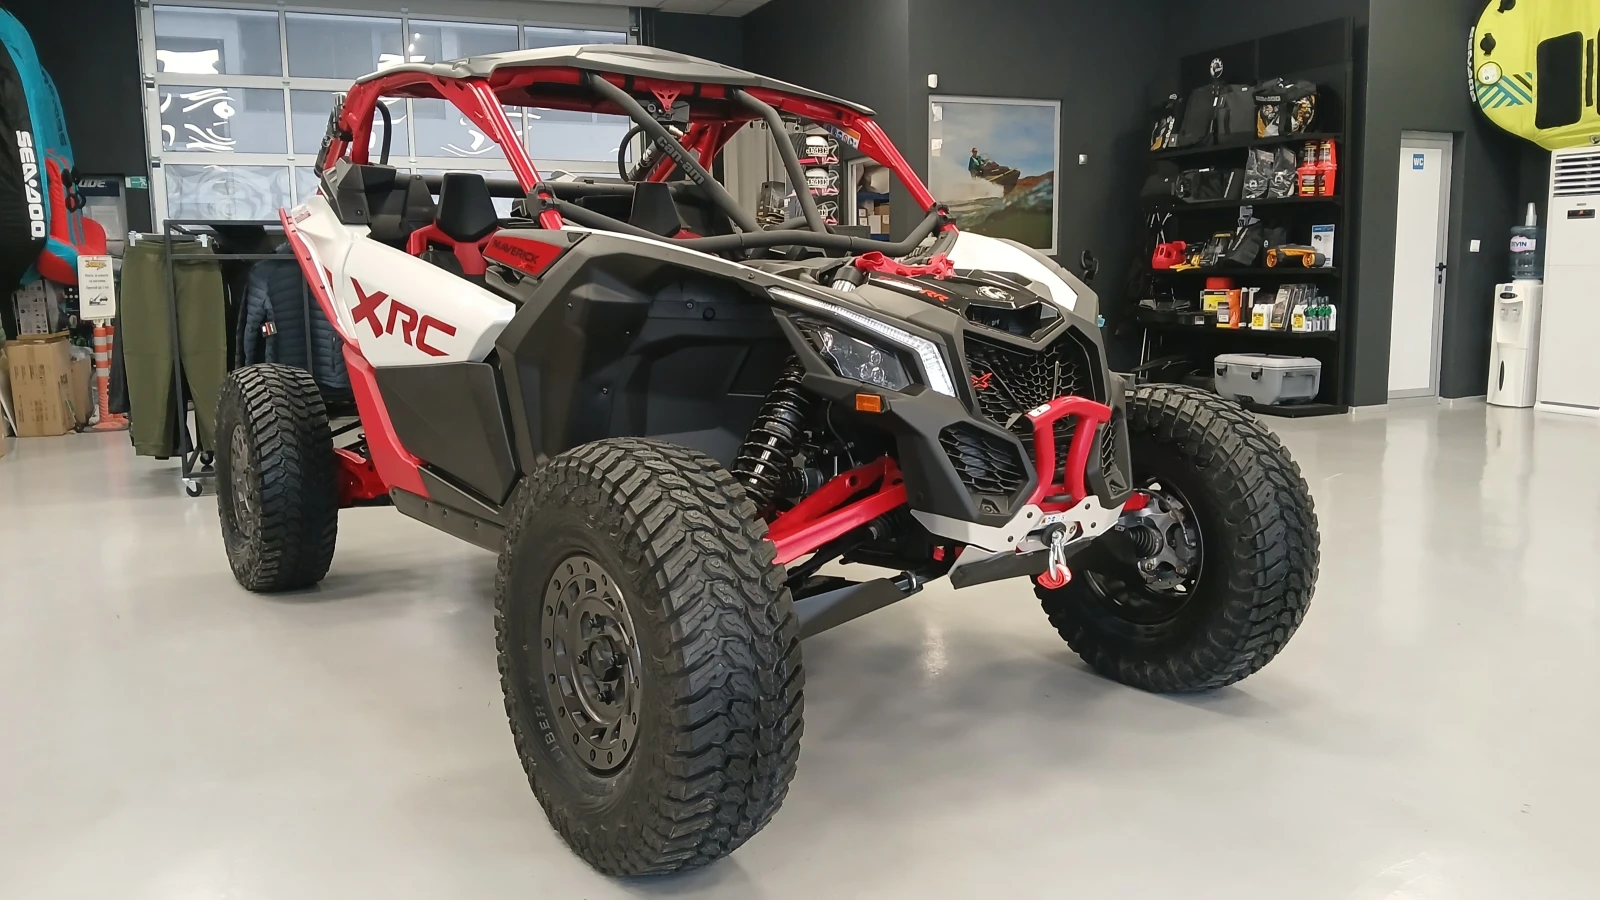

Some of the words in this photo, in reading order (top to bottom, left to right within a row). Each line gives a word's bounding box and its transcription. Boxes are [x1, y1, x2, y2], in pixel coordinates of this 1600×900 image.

[656, 136, 705, 185] can-am
[1413, 157, 1424, 166] WC
[78, 179, 106, 188] UDE
[492, 239, 541, 264] MAVERICK
[350, 276, 457, 357] XRC
[526, 674, 567, 762] LIBERTY
